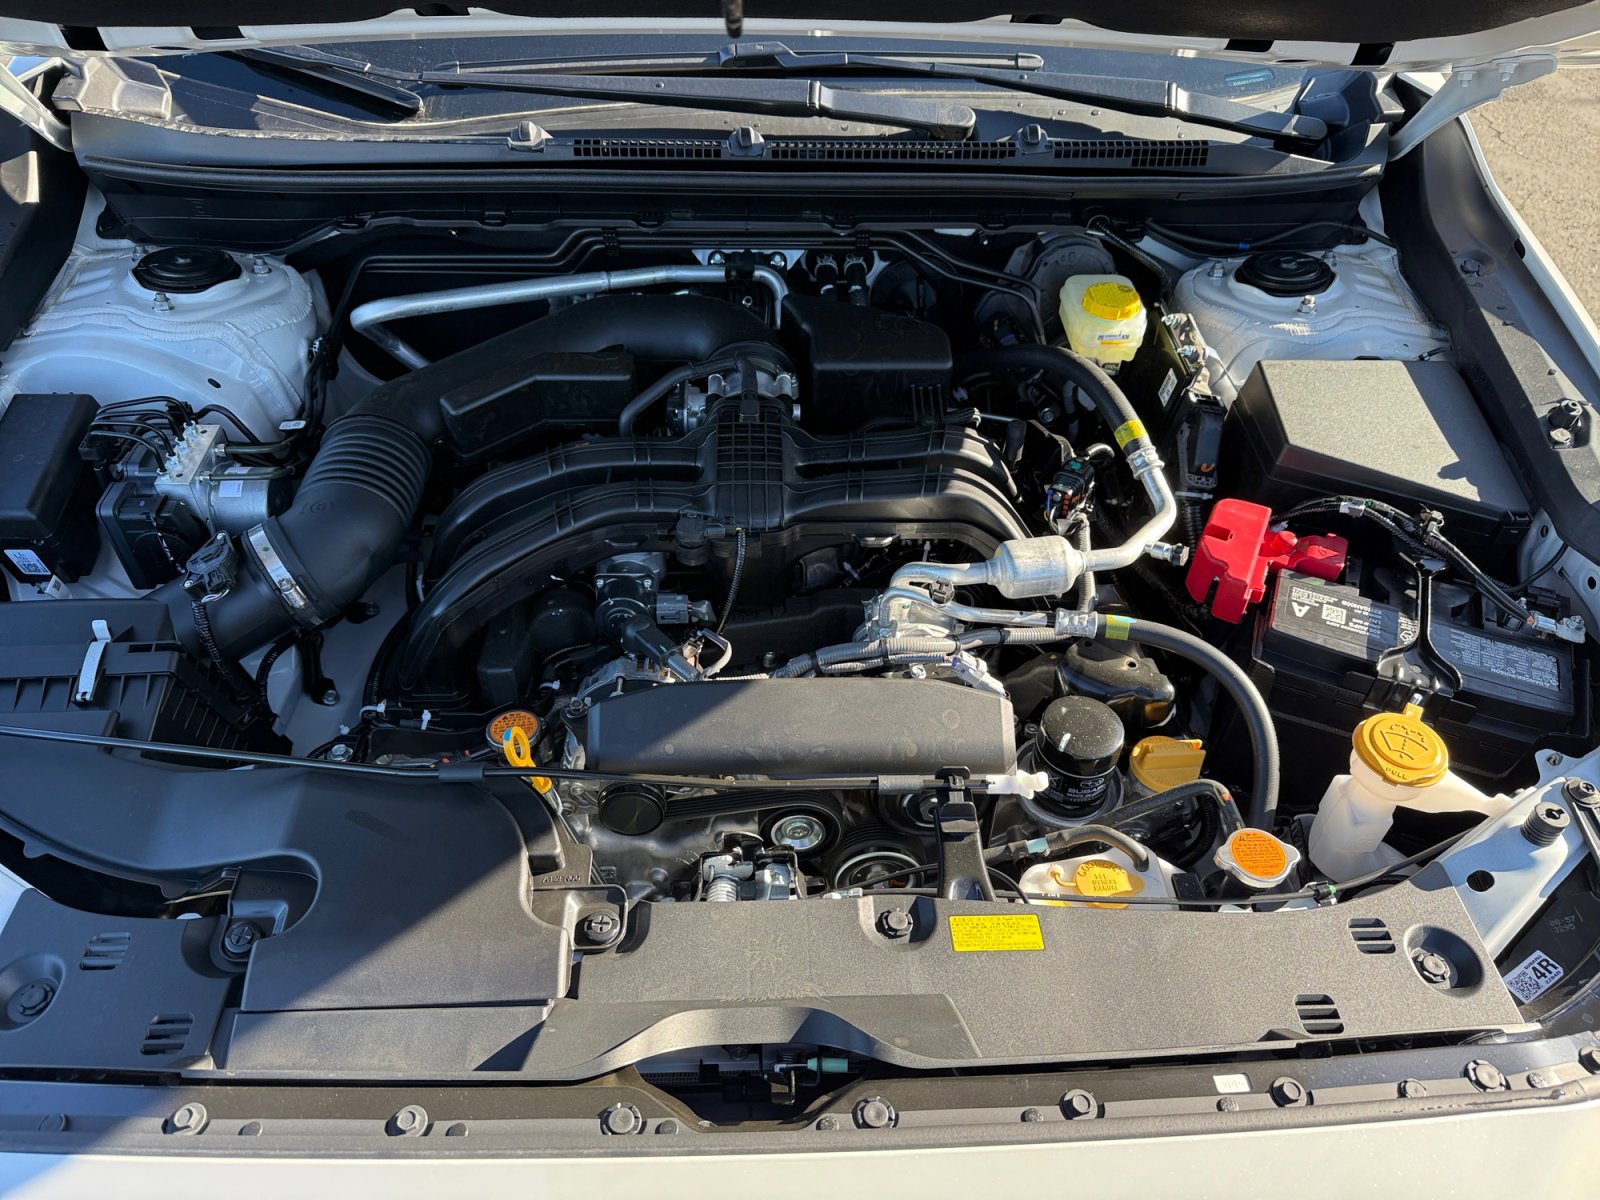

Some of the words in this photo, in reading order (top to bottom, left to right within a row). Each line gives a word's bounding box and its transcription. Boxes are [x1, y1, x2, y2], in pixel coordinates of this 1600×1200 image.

[1291, 601, 1311, 617] A
[1385, 766, 1407, 780] PULL
[1531, 958, 1559, 980] 4R
